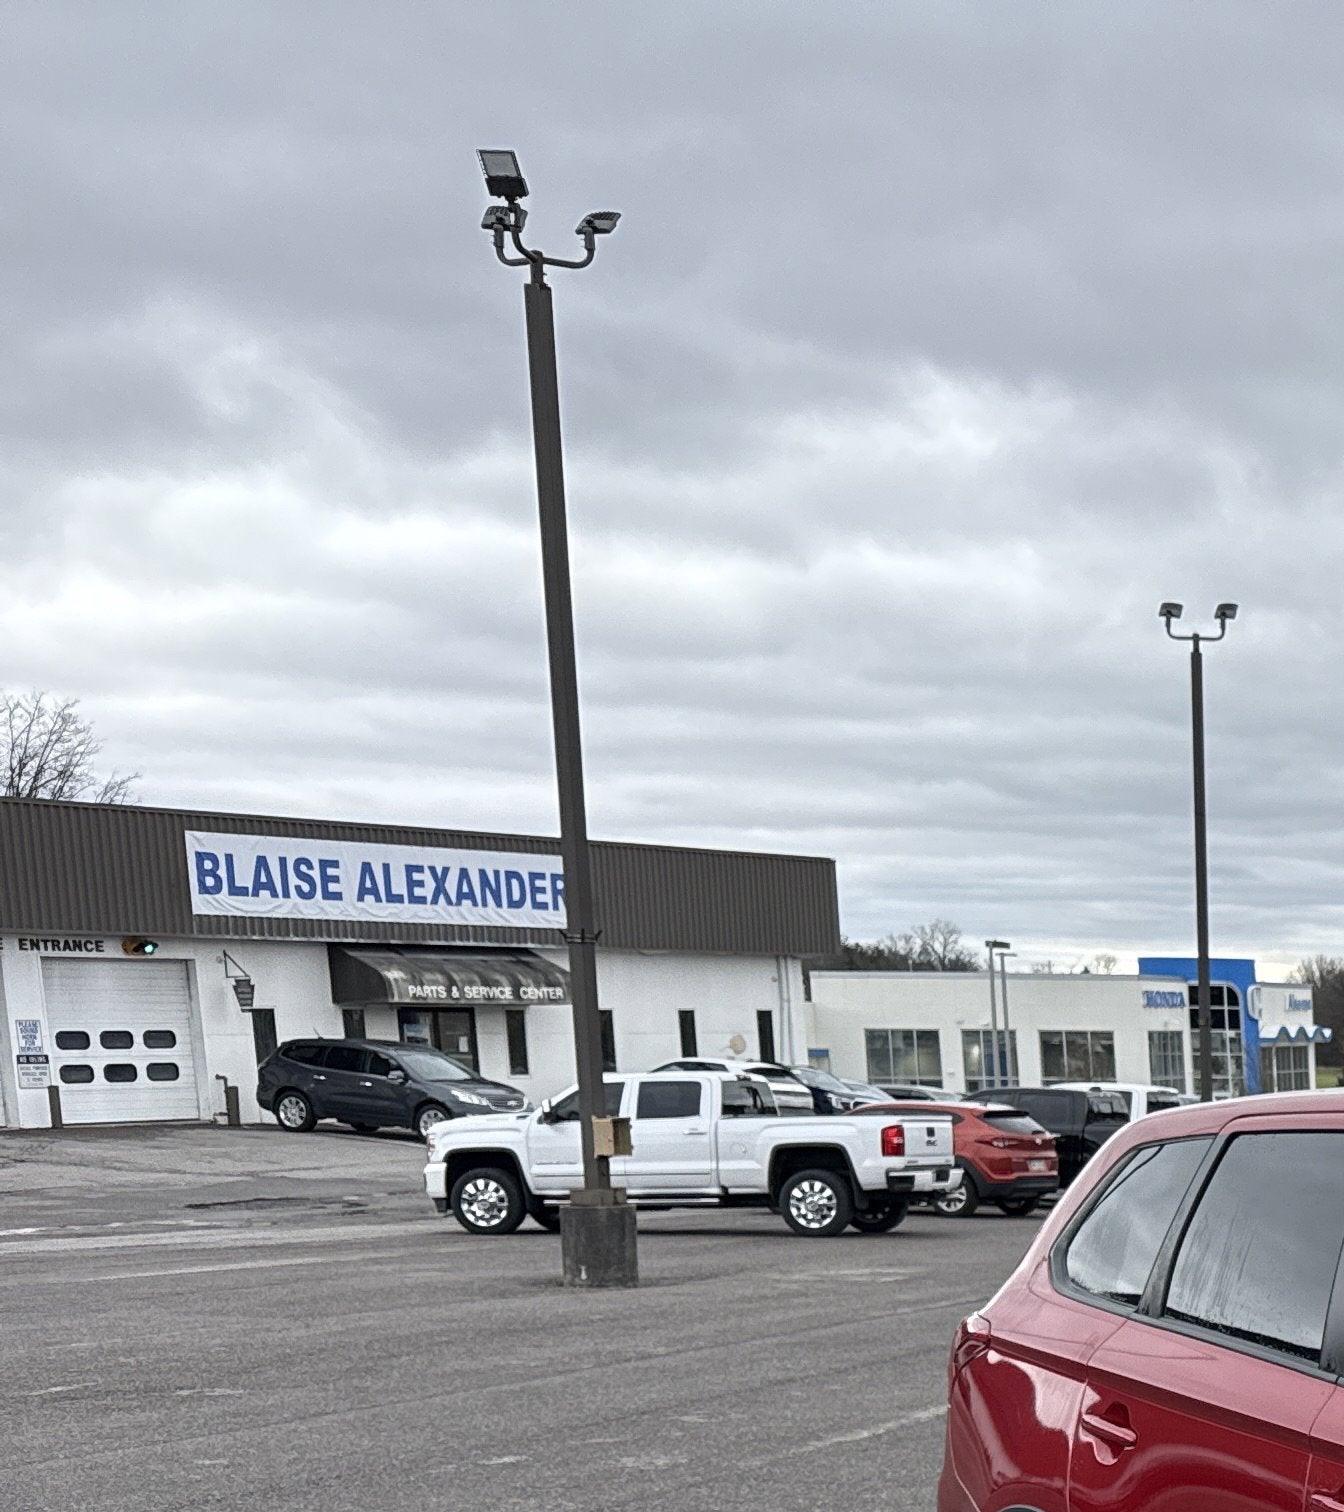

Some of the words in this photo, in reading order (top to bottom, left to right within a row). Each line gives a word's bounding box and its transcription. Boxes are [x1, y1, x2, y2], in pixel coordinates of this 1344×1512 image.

[195, 850, 343, 901] BLAISE
[357, 861, 565, 912] ALEXANDER
[18, 938, 105, 952] ENTRANCE
[408, 985, 447, 999] PARTS
[451, 986, 460, 999] &
[464, 986, 513, 1000] SERVICE
[519, 986, 564, 1000] CENTER
[1142, 990, 1186, 1009] HONDA
